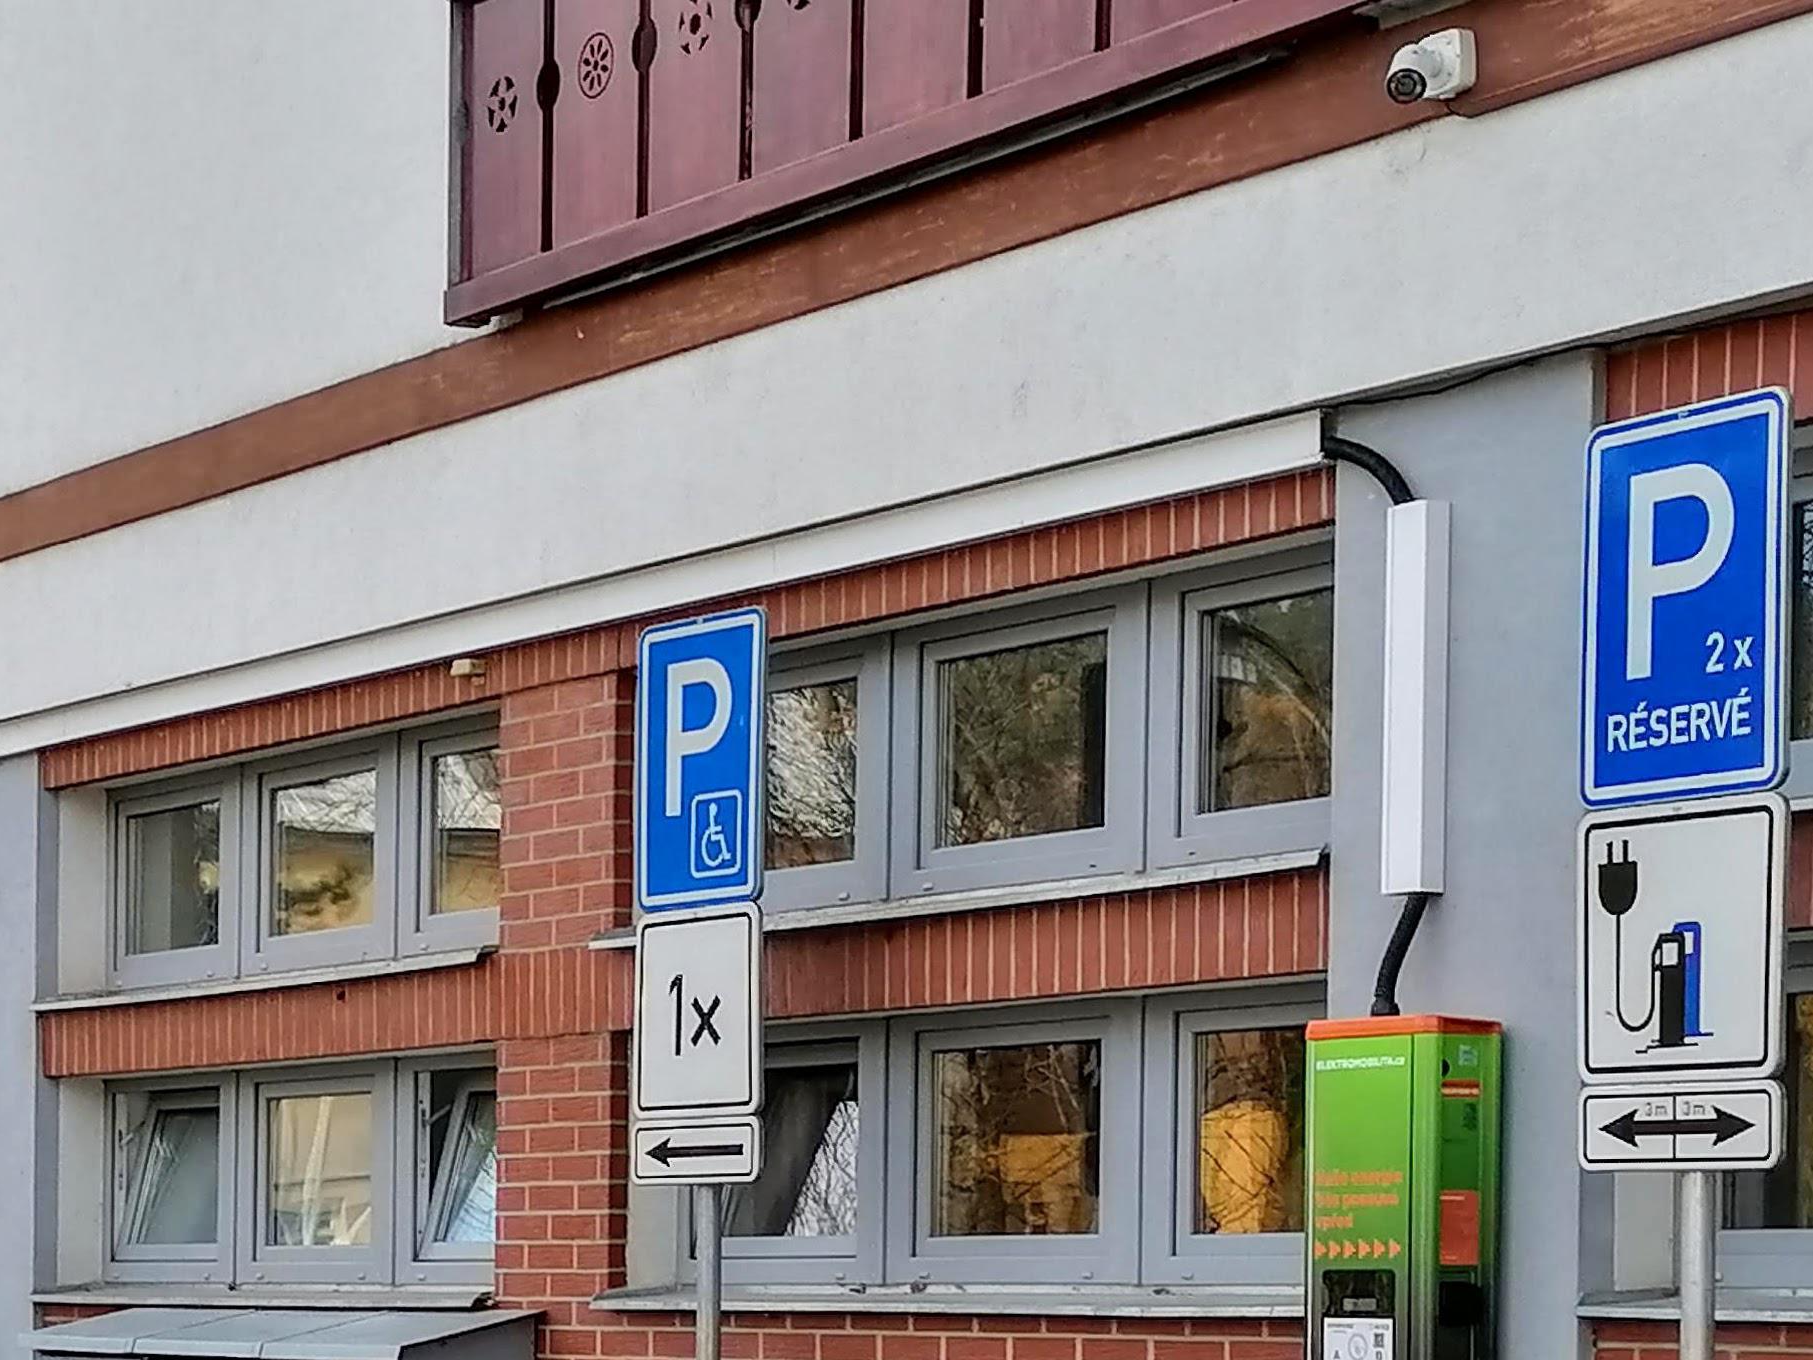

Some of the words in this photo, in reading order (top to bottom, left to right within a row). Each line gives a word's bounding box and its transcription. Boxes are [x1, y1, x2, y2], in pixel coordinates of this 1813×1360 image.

[1626, 462, 1735, 681] P
[664, 656, 733, 817] P
[1607, 687, 1753, 753] RÉSERVÉ
[668, 973, 721, 1058] 1x
[1644, 1102, 1668, 1117] 3m
[1682, 1100, 1706, 1117] 3m
